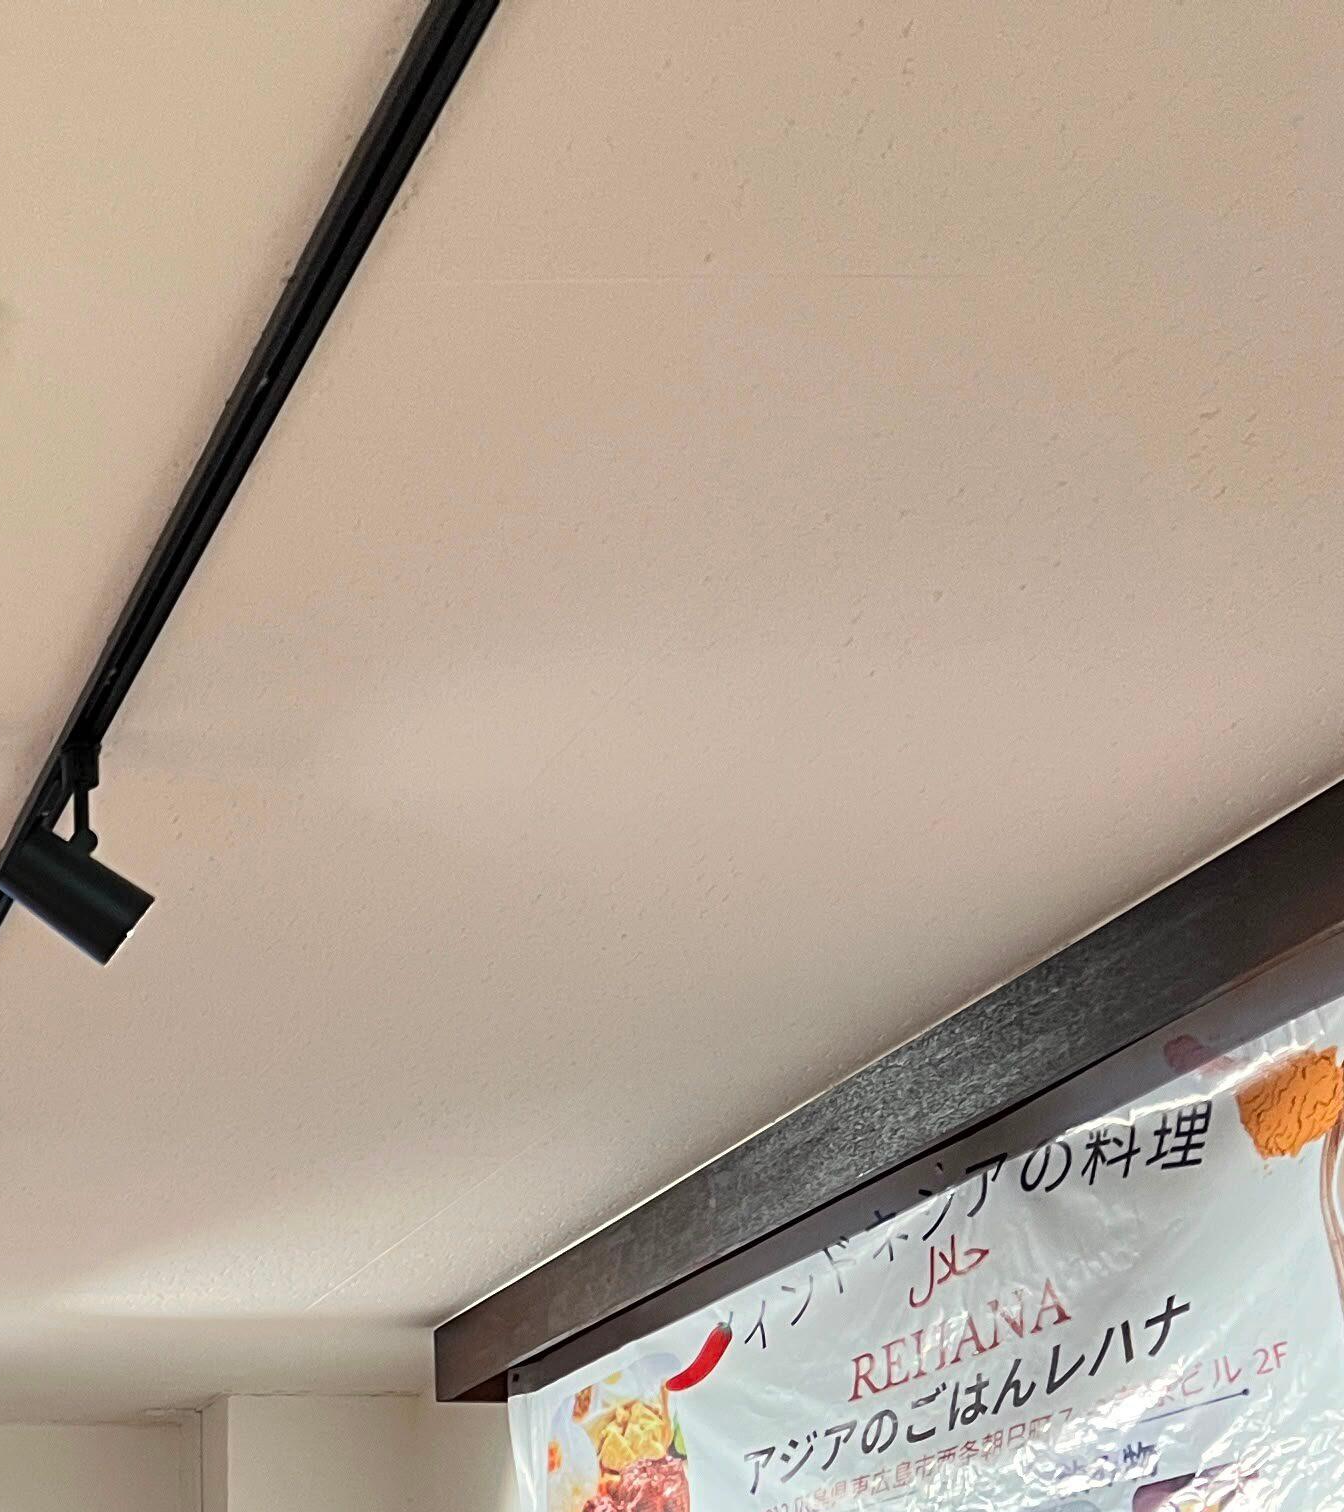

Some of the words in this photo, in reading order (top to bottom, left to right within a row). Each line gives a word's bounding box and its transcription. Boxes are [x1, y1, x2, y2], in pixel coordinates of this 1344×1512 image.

[908, 1235, 990, 1308] حلال
[848, 1277, 1072, 1402] REHANA
[1254, 1341, 1288, 1376] 2F
[744, 1295, 1192, 1495] アジアのごはんレハナ
